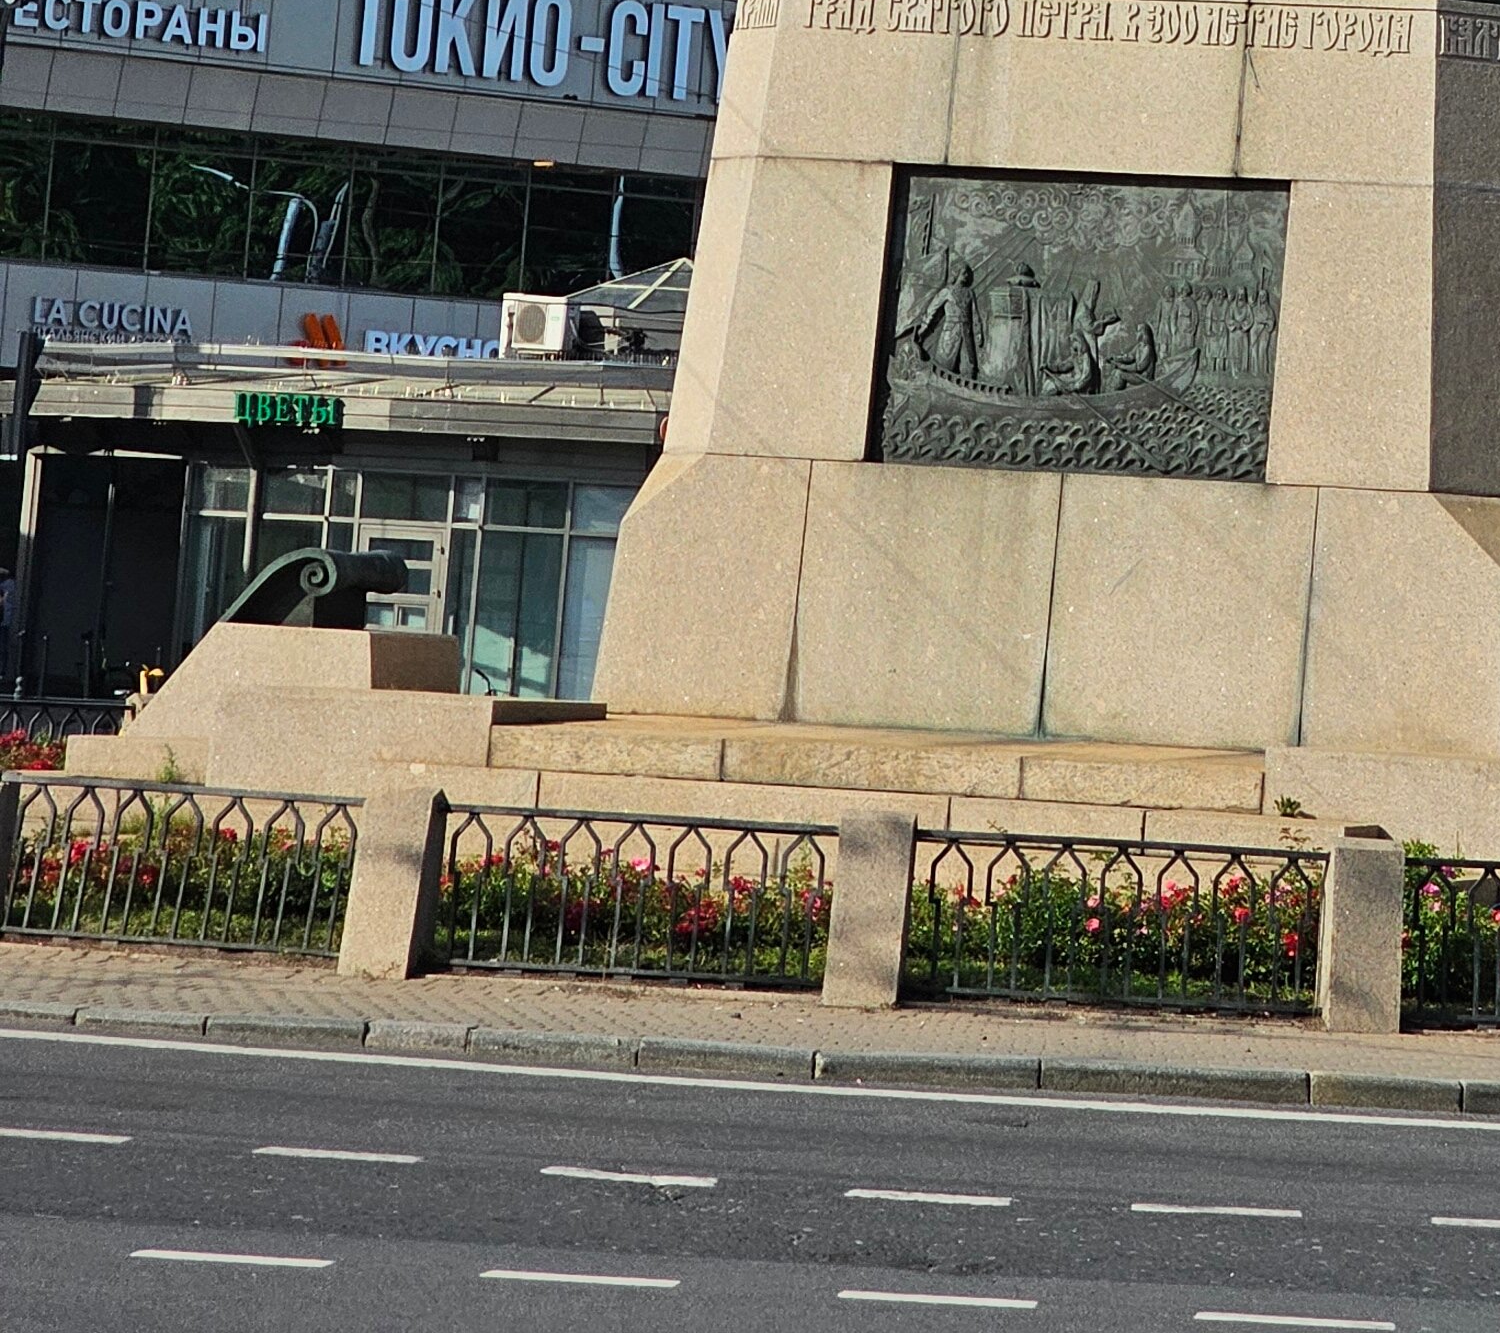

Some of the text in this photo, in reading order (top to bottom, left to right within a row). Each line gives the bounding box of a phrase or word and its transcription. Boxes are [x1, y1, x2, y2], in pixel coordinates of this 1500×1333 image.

[34, 296, 193, 336] LA CUCINA
[234, 392, 340, 427] ЦВЕТЫ
